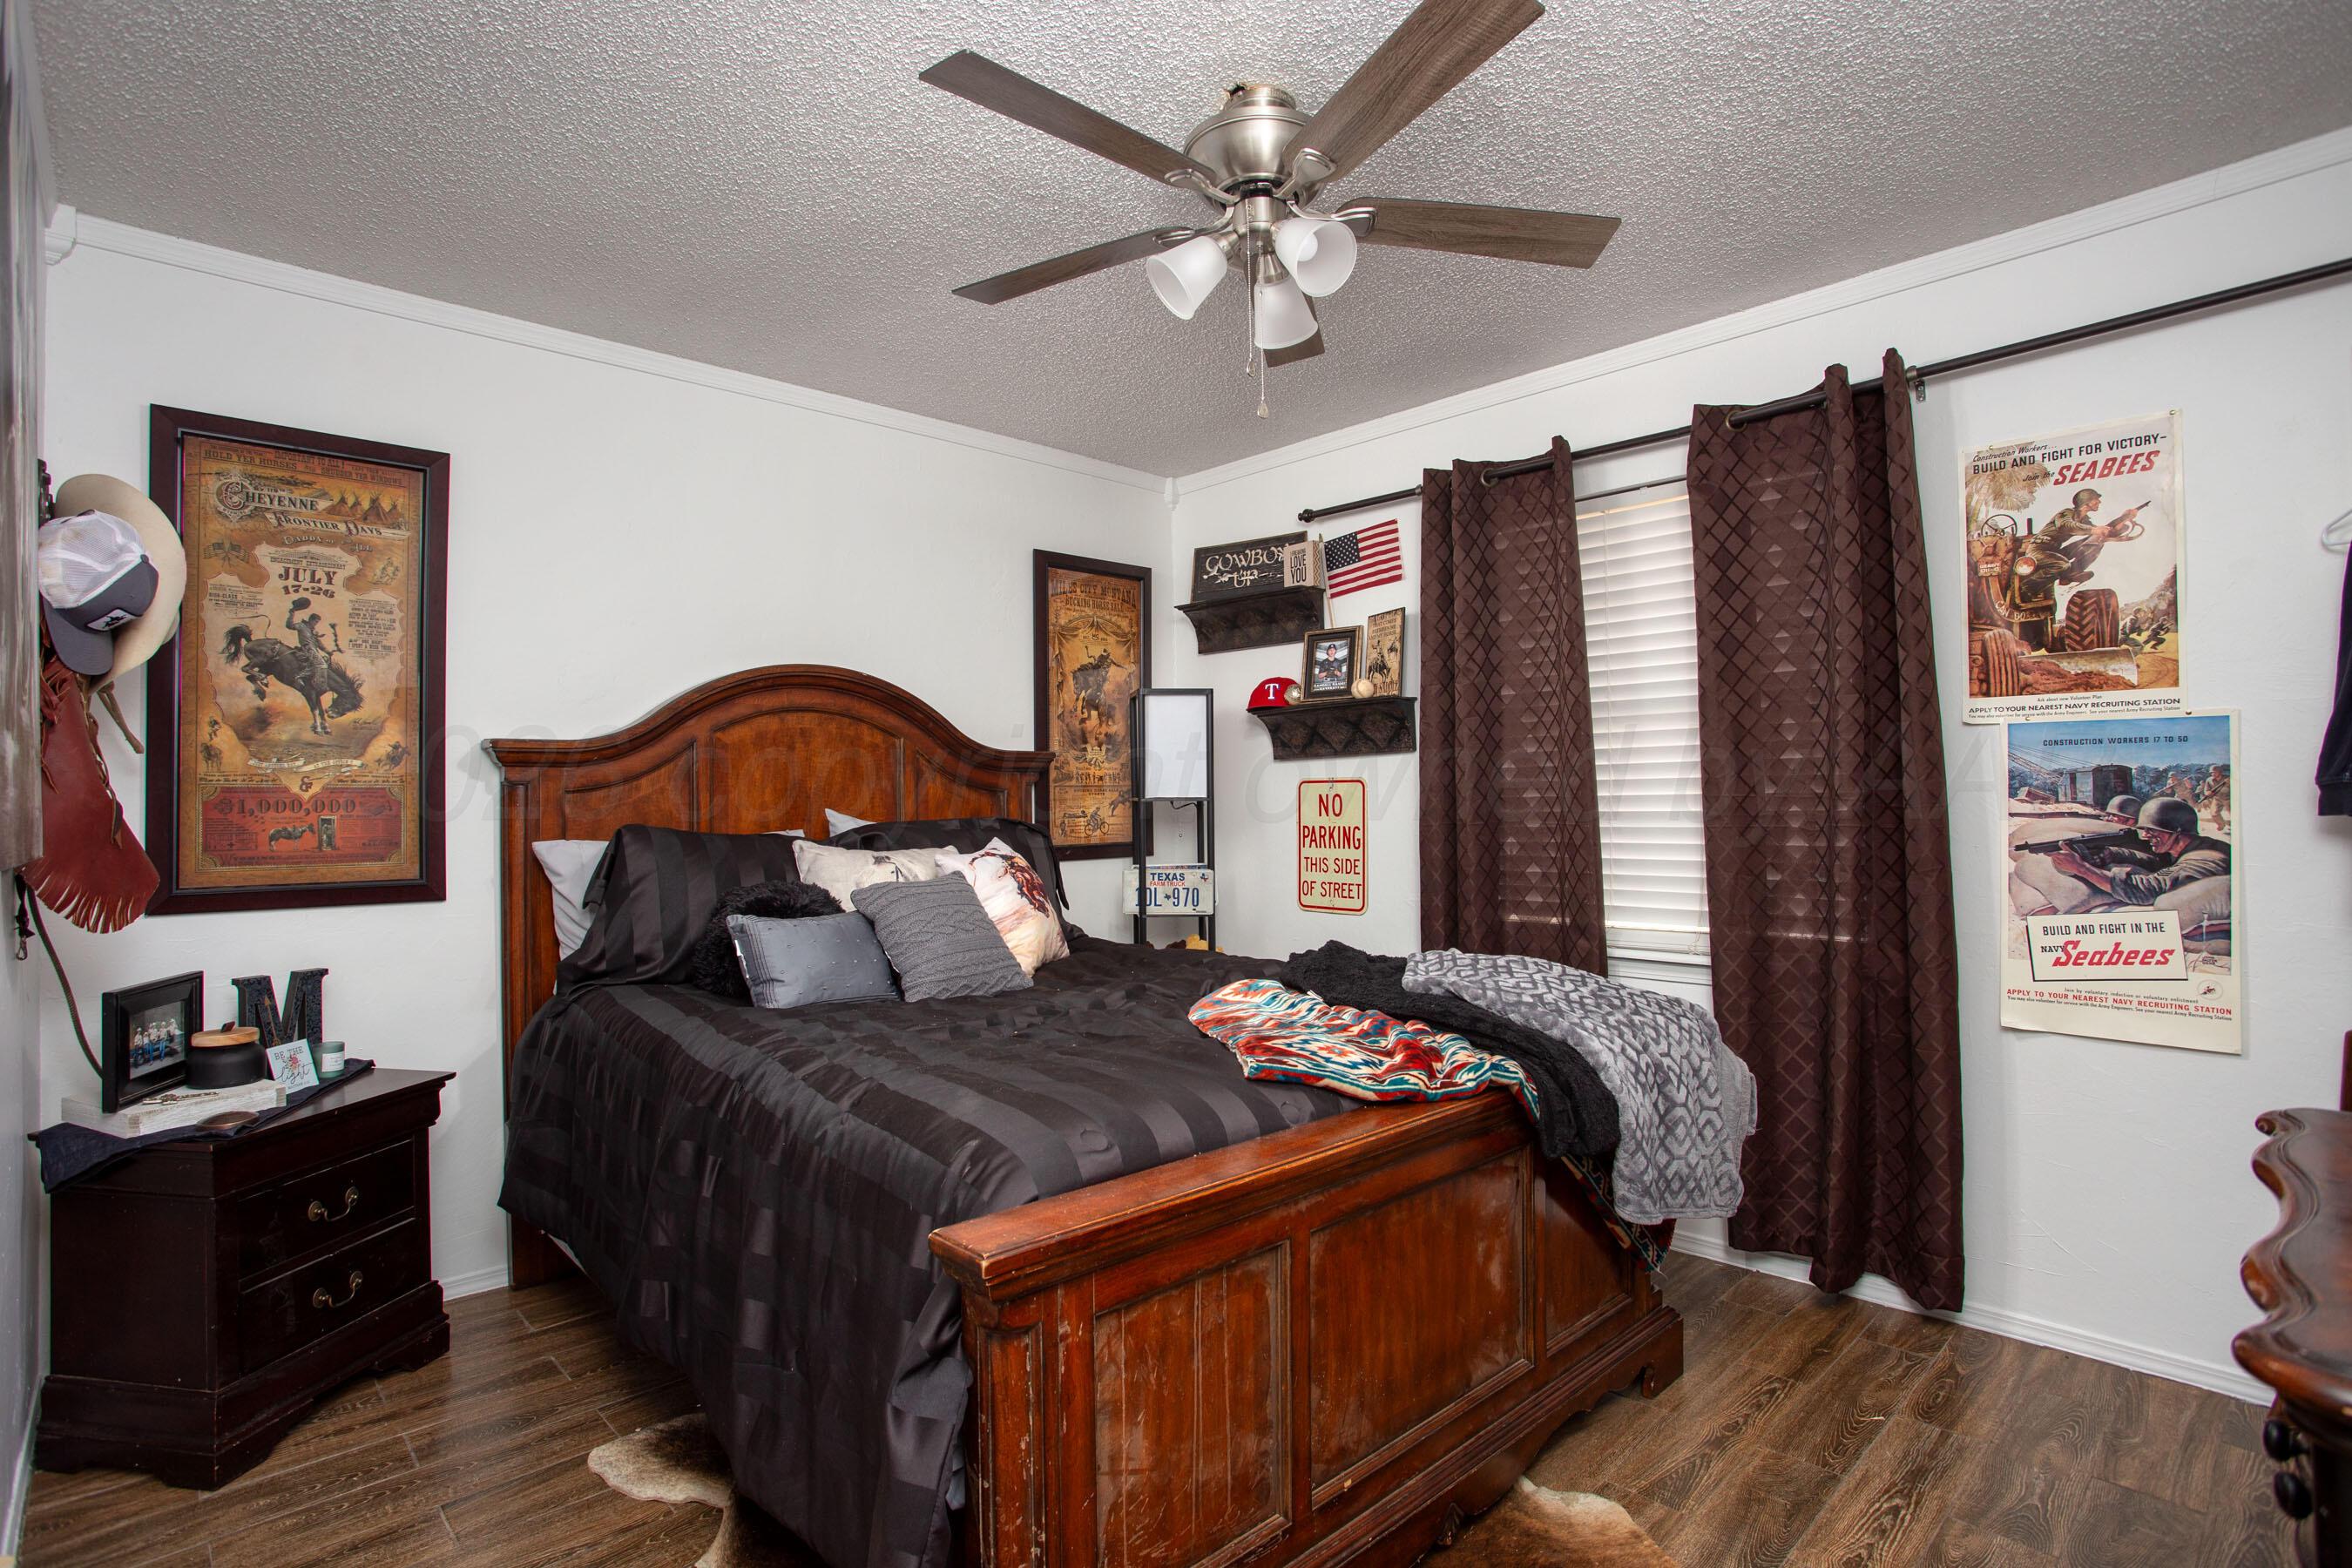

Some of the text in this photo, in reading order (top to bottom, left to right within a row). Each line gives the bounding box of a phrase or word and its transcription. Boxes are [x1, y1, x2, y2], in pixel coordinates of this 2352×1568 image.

[204, 450, 233, 460] HOLD
[236, 454, 256, 463] YER
[1972, 449, 2016, 463] Construction
[1973, 459, 2006, 475] BUILD
[2011, 455, 2036, 469] AND
[2041, 448, 2074, 463] FIGHT
[2078, 442, 2102, 456] FOR
[2022, 470, 2056, 483] Join the
[2053, 449, 2160, 486] SEABEES
[220, 480, 319, 512] CHEYENNE
[274, 512, 382, 536] FRONTIER DAYS
[1290, 554, 1307, 569] LOVE
[279, 566, 338, 586] JULY
[1233, 569, 1259, 588] UP
[1290, 566, 1307, 585] YOU
[281, 585, 335, 598] 17-26
[1051, 578, 1137, 610] MILES CITY MONTANA
[1065, 595, 1091, 608] BUCKING
[1265, 683, 1281, 700] T
[2091, 700, 2140, 708] RECRUITING
[2043, 738, 2104, 747] CONSTRUCTION
[1318, 793, 1342, 817] NO
[1302, 825, 1362, 850] PARKING
[1303, 856, 1361, 875] THIS SIDE
[1150, 872, 1185, 882] TEXAS
[1173, 888, 1200, 907] 970
[1302, 882, 1362, 901] OF STREET
[2043, 922, 2166, 936] BUILD AND FIGHT IN THE
[2040, 945, 2065, 954] NAVY
[2051, 939, 2175, 968] Seabees
[2006, 988, 2031, 997] APPLY
[2047, 991, 2069, 1000] YOUR
[2072, 994, 2109, 1004] NEAREST
[2137, 1000, 2190, 1011] RECRUITING
[2193, 1005, 2233, 1016] STATION
[274, 1046, 304, 1060] BE THE
[275, 1062, 314, 1084] light
